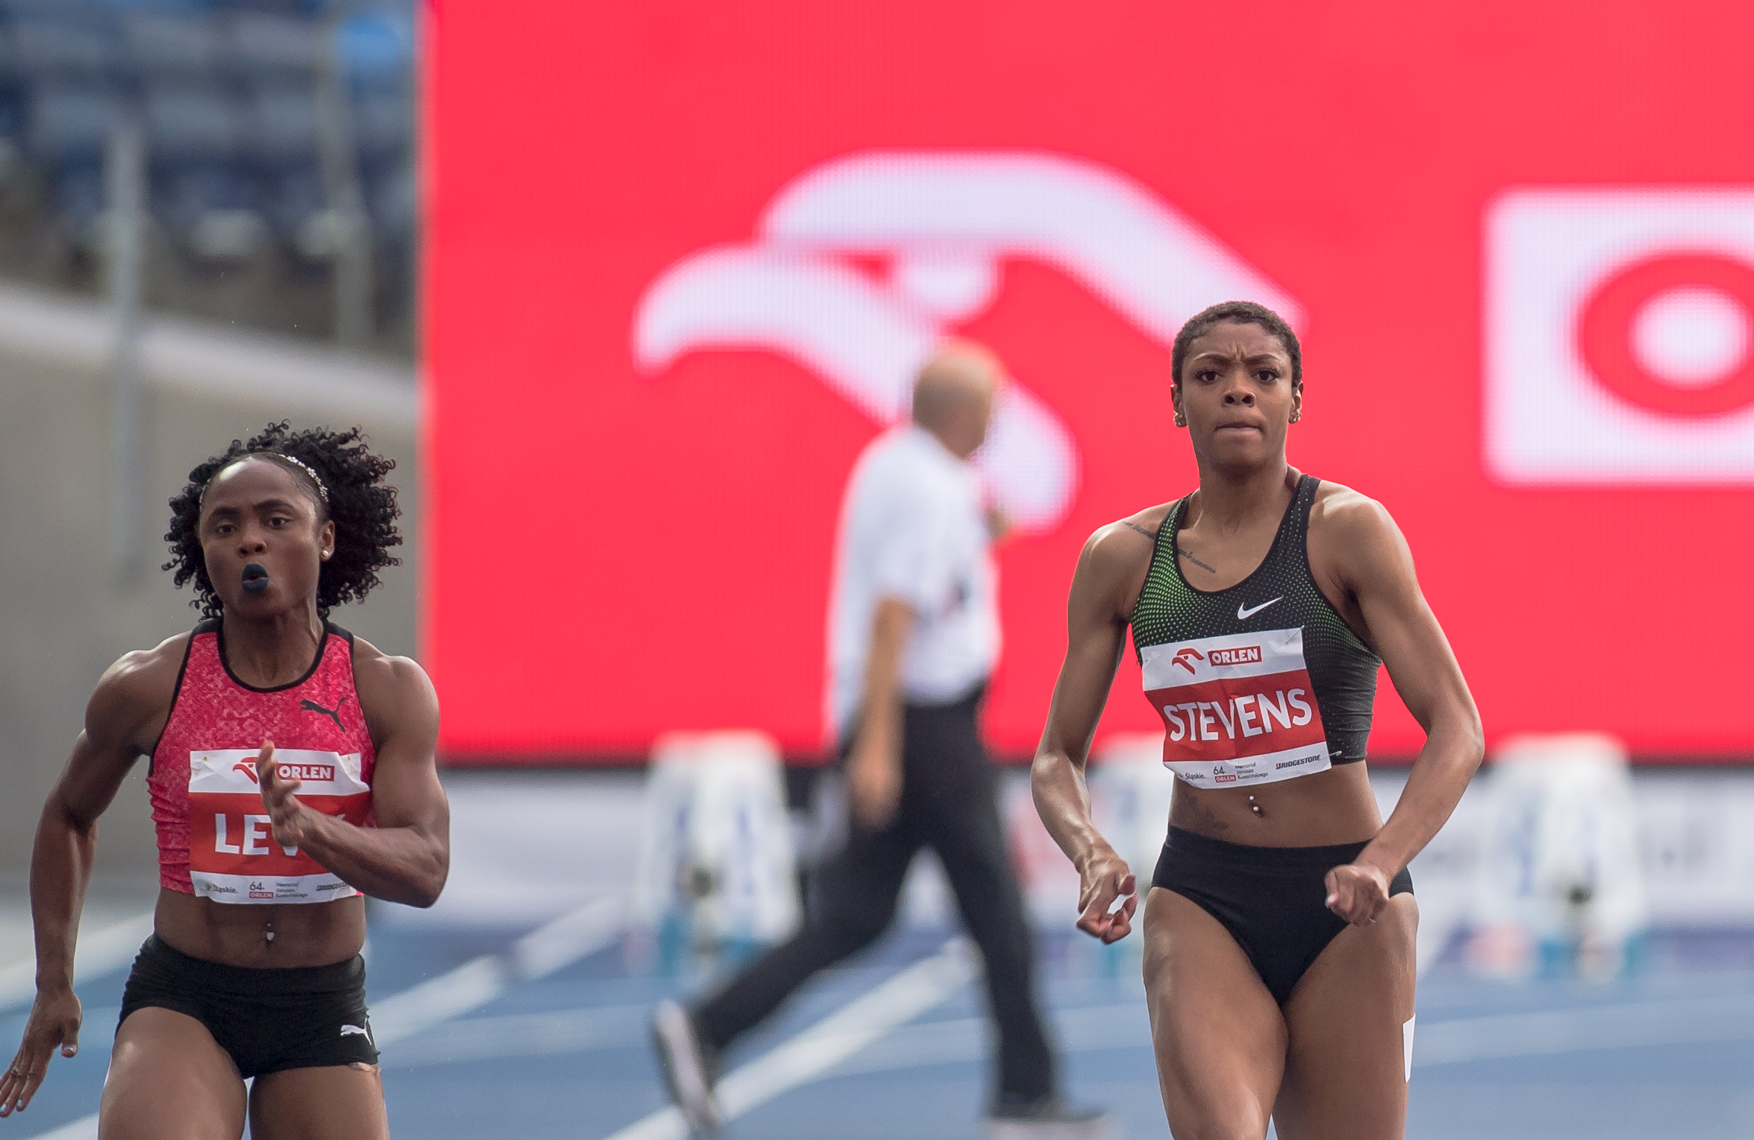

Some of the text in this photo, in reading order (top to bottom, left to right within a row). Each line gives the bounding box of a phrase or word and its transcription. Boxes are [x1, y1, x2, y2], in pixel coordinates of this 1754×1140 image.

[1210, 648, 1259, 665] ORLEN
[1163, 688, 1313, 742] STEVENS
[1275, 754, 1321, 770] BRIDGESTONE
[278, 764, 332, 779] ORLEN
[214, 813, 346, 857] LE
